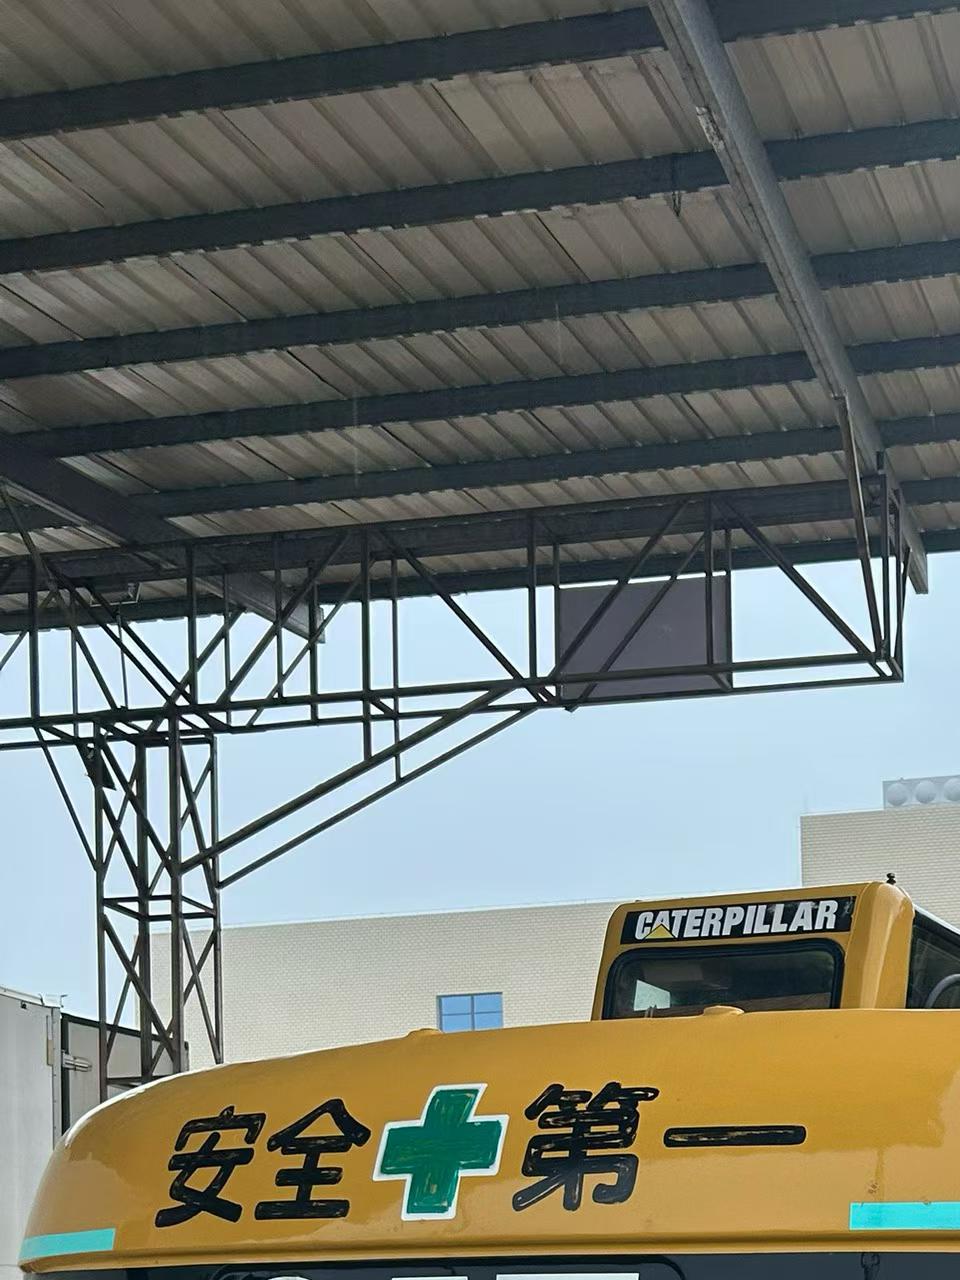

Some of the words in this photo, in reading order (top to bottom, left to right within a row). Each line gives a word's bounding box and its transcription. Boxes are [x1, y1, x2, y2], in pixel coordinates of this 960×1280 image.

[634, 900, 838, 941] CATERPILLAR
[155, 1098, 371, 1228] 安全
[512, 1081, 807, 1212] 第一
